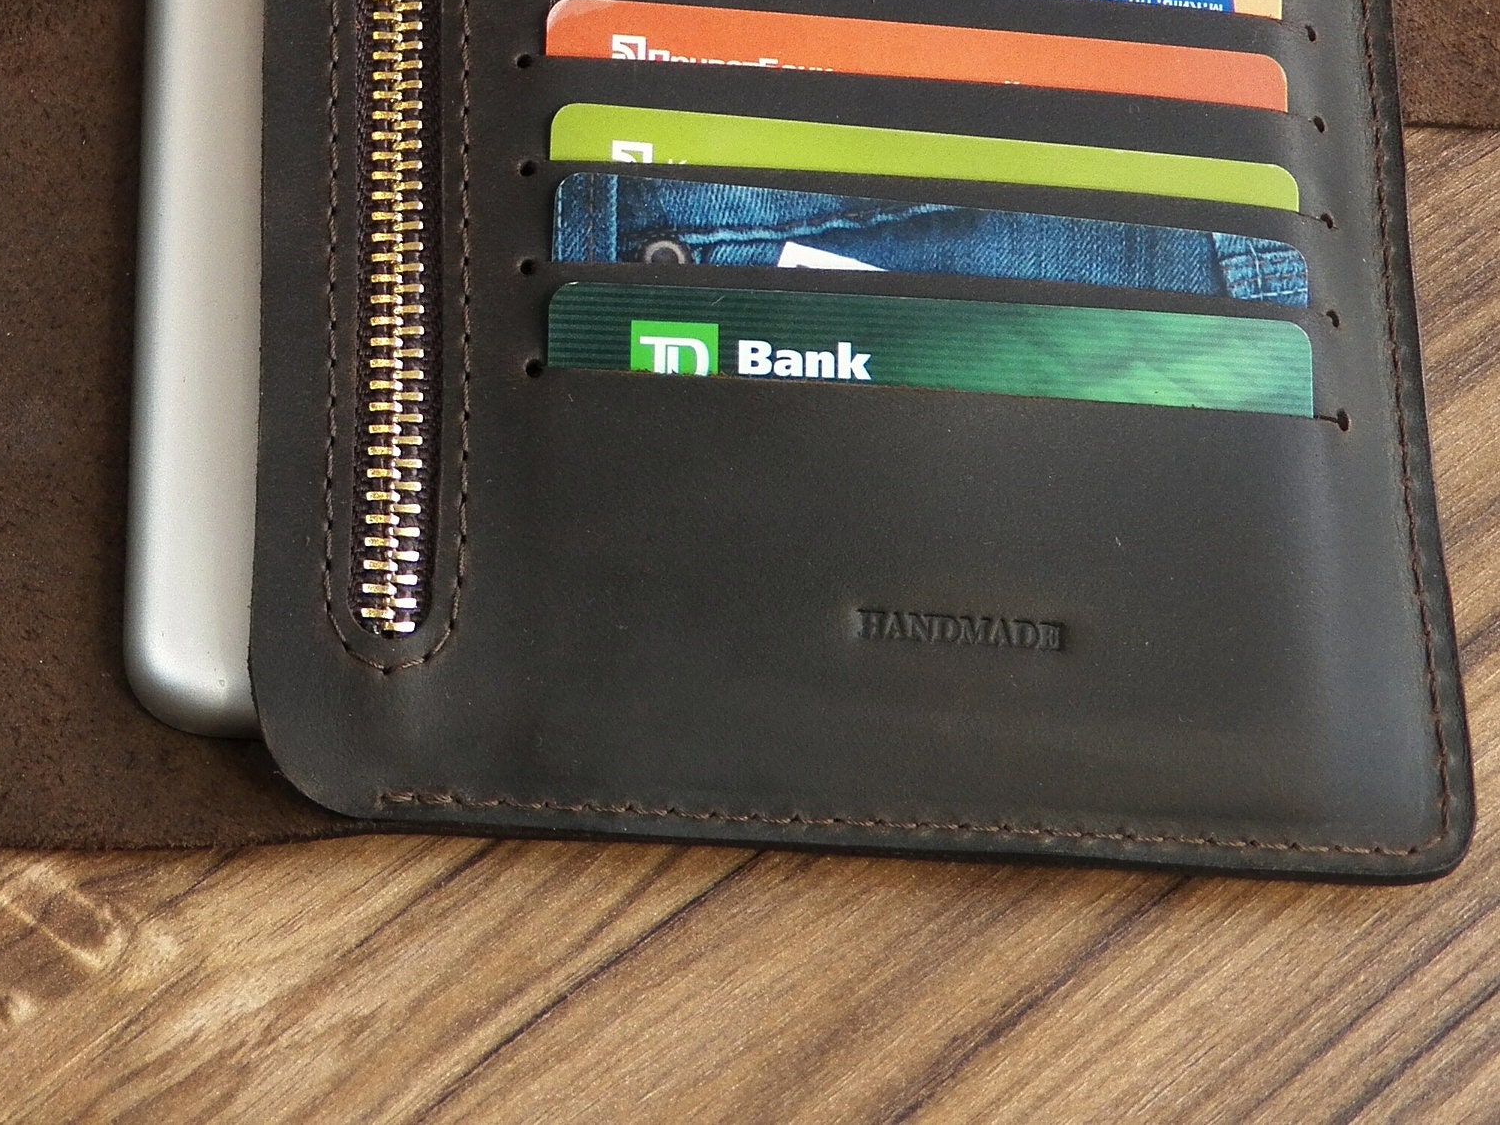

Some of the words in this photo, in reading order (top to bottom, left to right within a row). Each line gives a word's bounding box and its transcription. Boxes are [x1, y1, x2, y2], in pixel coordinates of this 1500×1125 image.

[640, 336, 711, 377] TD
[738, 339, 873, 381] Bank
[855, 608, 1066, 652] HANDMADE
